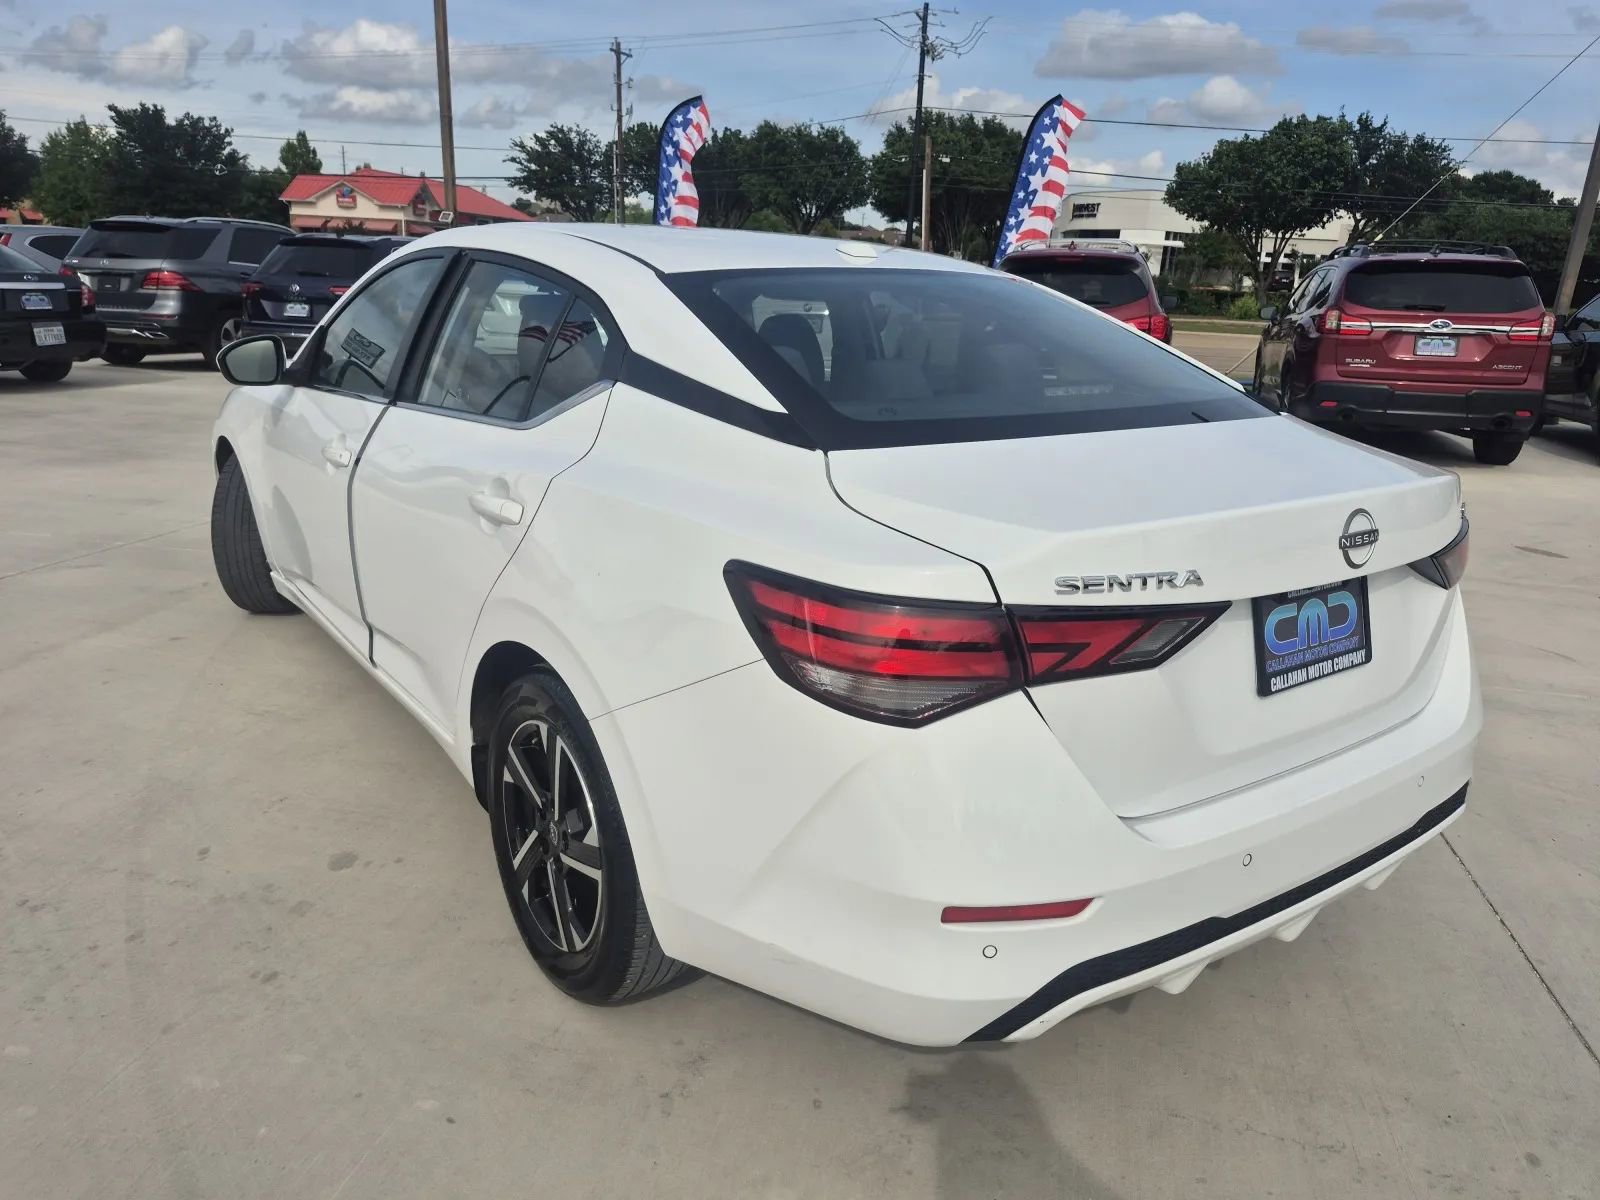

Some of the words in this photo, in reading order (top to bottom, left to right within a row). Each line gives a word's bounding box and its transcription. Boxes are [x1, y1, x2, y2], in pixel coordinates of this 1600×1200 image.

[1341, 531, 1379, 548] NISSAN
[1054, 569, 1204, 595] SENTRA
[1266, 652, 1303, 672] CALLAHAN
[1305, 644, 1328, 662] MOTOR
[1329, 636, 1359, 655] COMPANY
[1270, 667, 1307, 692] CALLAHAN
[1308, 660, 1333, 679] MOTOR
[1333, 649, 1366, 671] COMPANY
